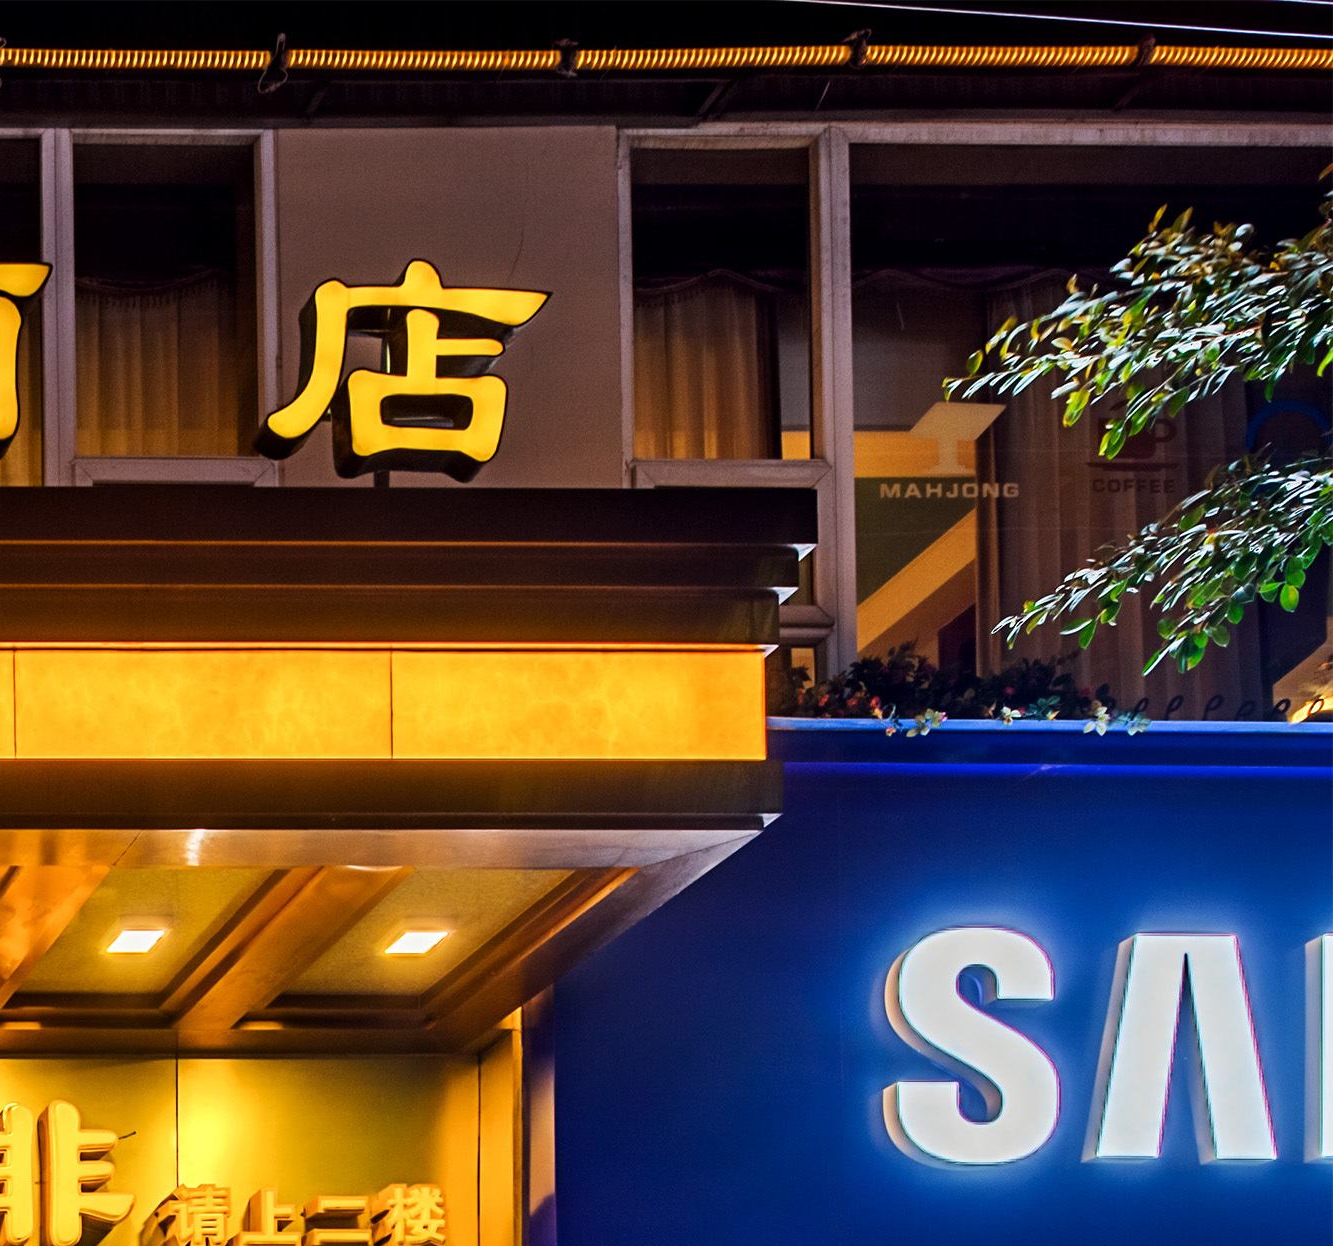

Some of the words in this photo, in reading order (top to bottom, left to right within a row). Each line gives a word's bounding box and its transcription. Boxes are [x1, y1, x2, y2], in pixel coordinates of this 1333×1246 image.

[880, 482, 1020, 500] MAHJONG
[1093, 478, 1175, 494] COFFEE
[883, 926, 1333, 1166] SA
